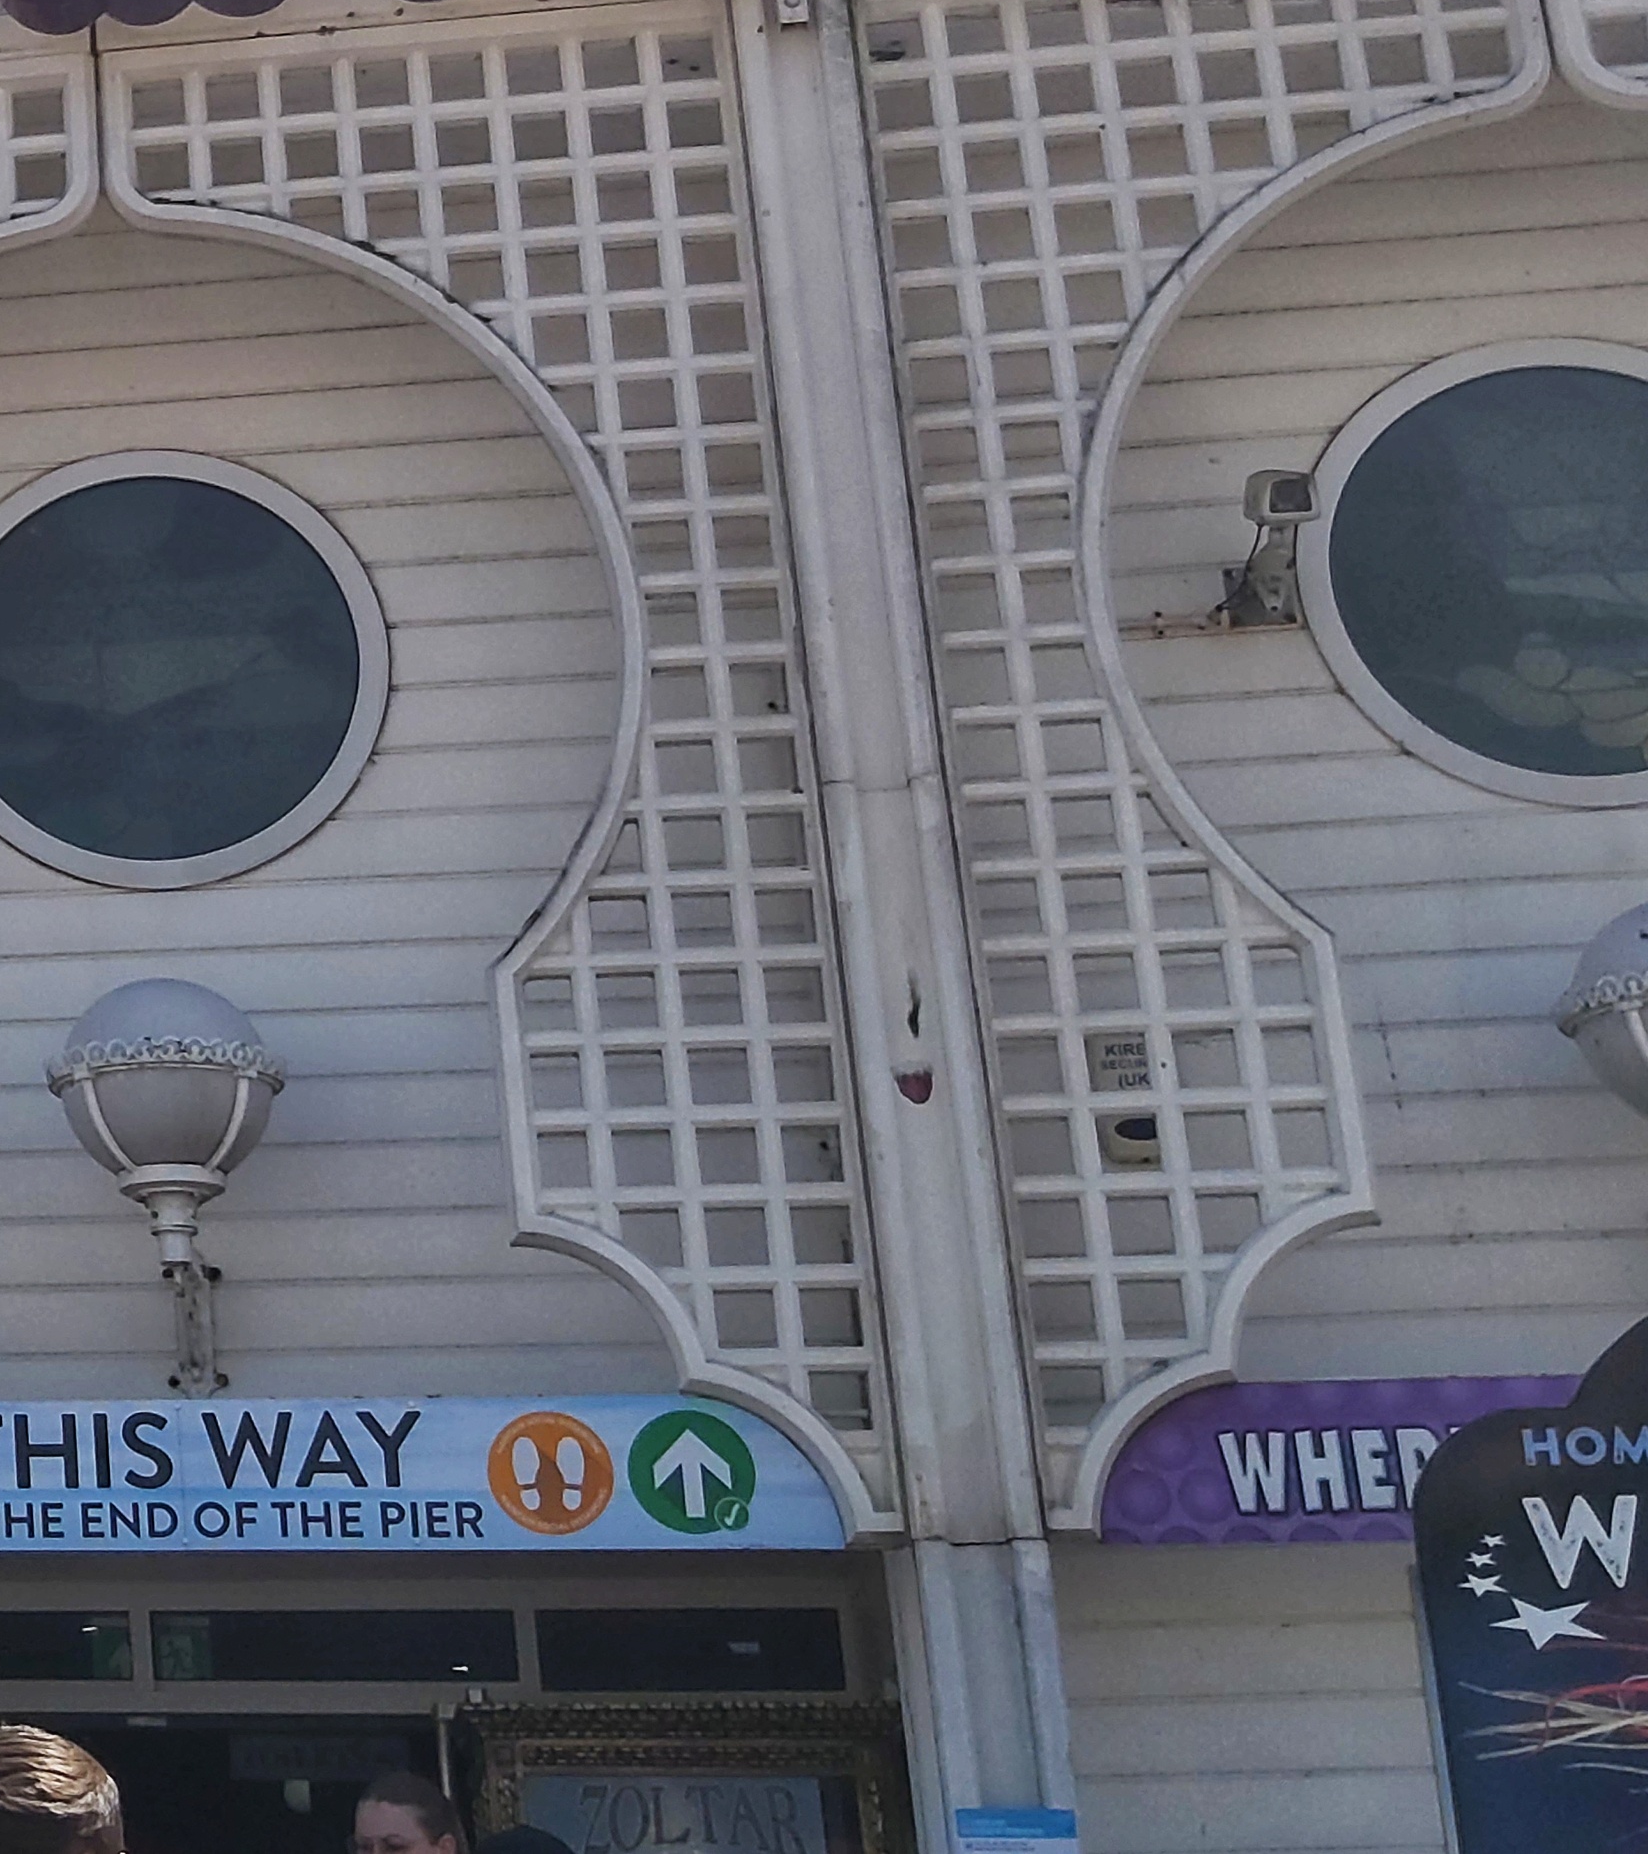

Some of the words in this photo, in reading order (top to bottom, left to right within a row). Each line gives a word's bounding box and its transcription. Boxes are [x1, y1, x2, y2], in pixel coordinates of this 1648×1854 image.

[200, 1409, 422, 1489] WAY
[1217, 1426, 1461, 1514] WHER
[80, 1501, 179, 1539] END
[192, 1501, 259, 1538] OF
[270, 1501, 366, 1538] THE
[379, 1500, 484, 1539] PIER
[580, 1783, 807, 1854] ZOLTAR
